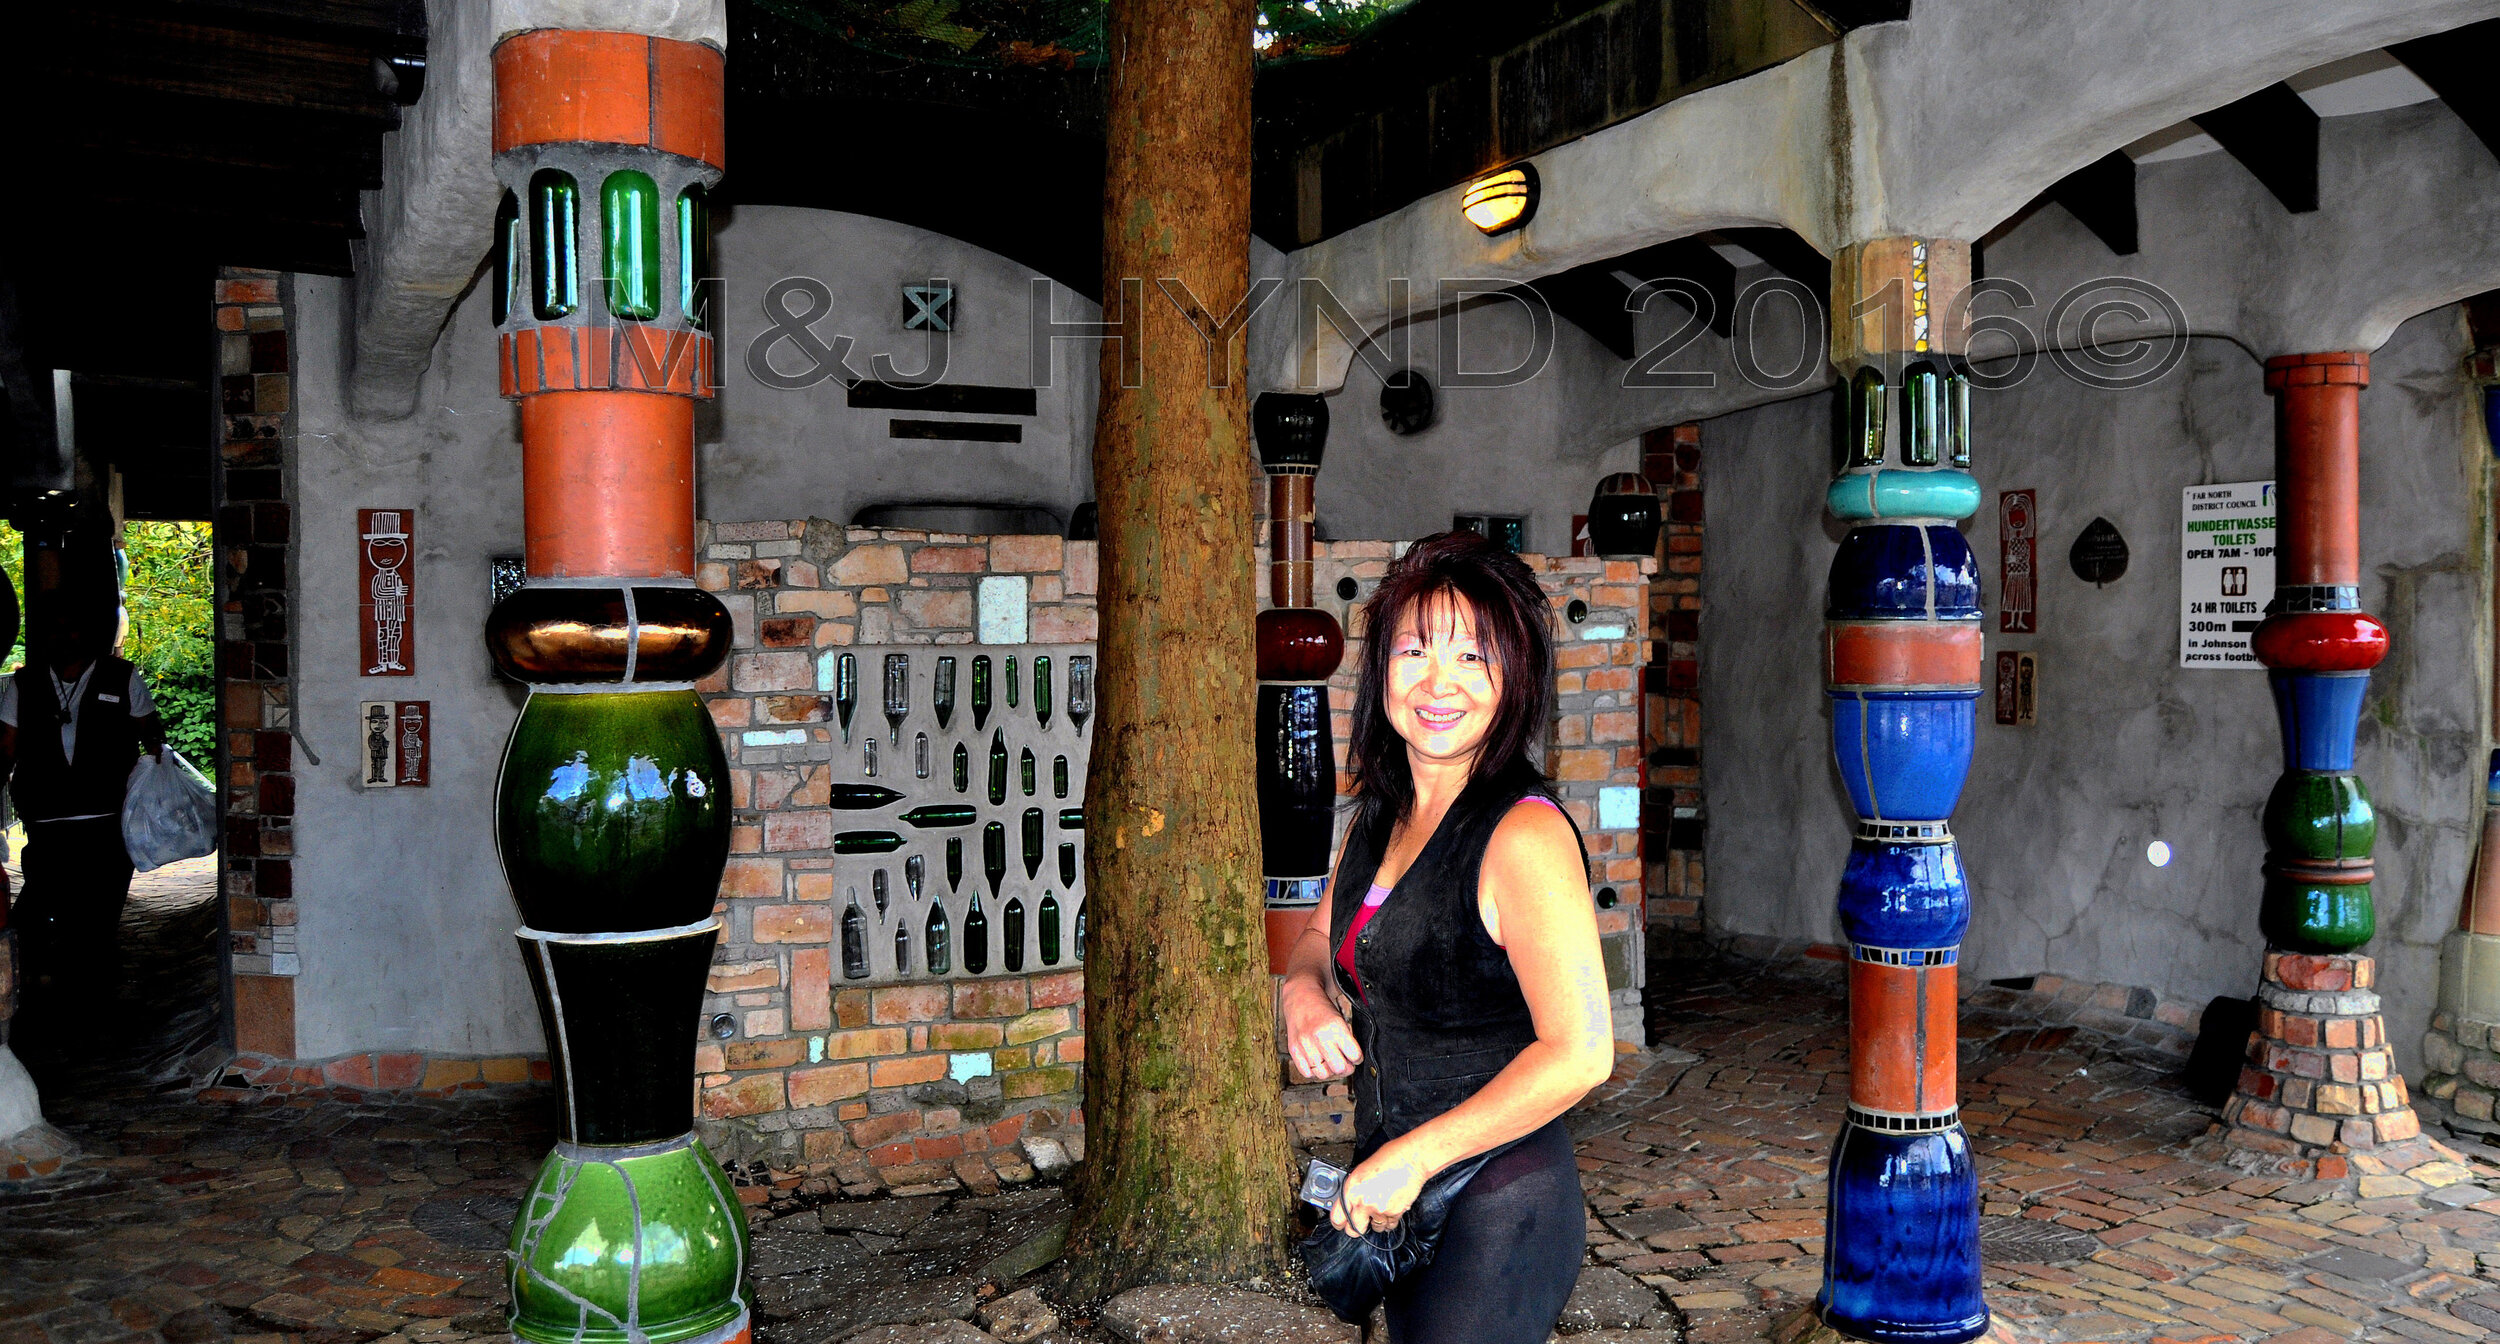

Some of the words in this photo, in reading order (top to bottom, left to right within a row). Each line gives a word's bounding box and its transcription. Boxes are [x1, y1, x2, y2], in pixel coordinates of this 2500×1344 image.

[2193, 492, 2206, 500] FAR
[2208, 490, 2232, 498] NORTH
[2192, 502, 2224, 511] DISTRICT
[2226, 500, 2257, 508] COUNCIL
[2187, 517, 2276, 532] HUNDERTWASSE
[2213, 533, 2256, 545] TOILETS
[2187, 549, 2214, 559] OPEN
[2218, 548, 2240, 558] 7AM
[2191, 602, 2202, 613] 24
[2205, 602, 2217, 613] HR
[2220, 602, 2257, 613] TOILETS
[2189, 621, 2226, 632] 300m
[2188, 639, 2198, 647] in
[2201, 639, 2247, 648] Johnson
[2185, 653, 2221, 662] across
